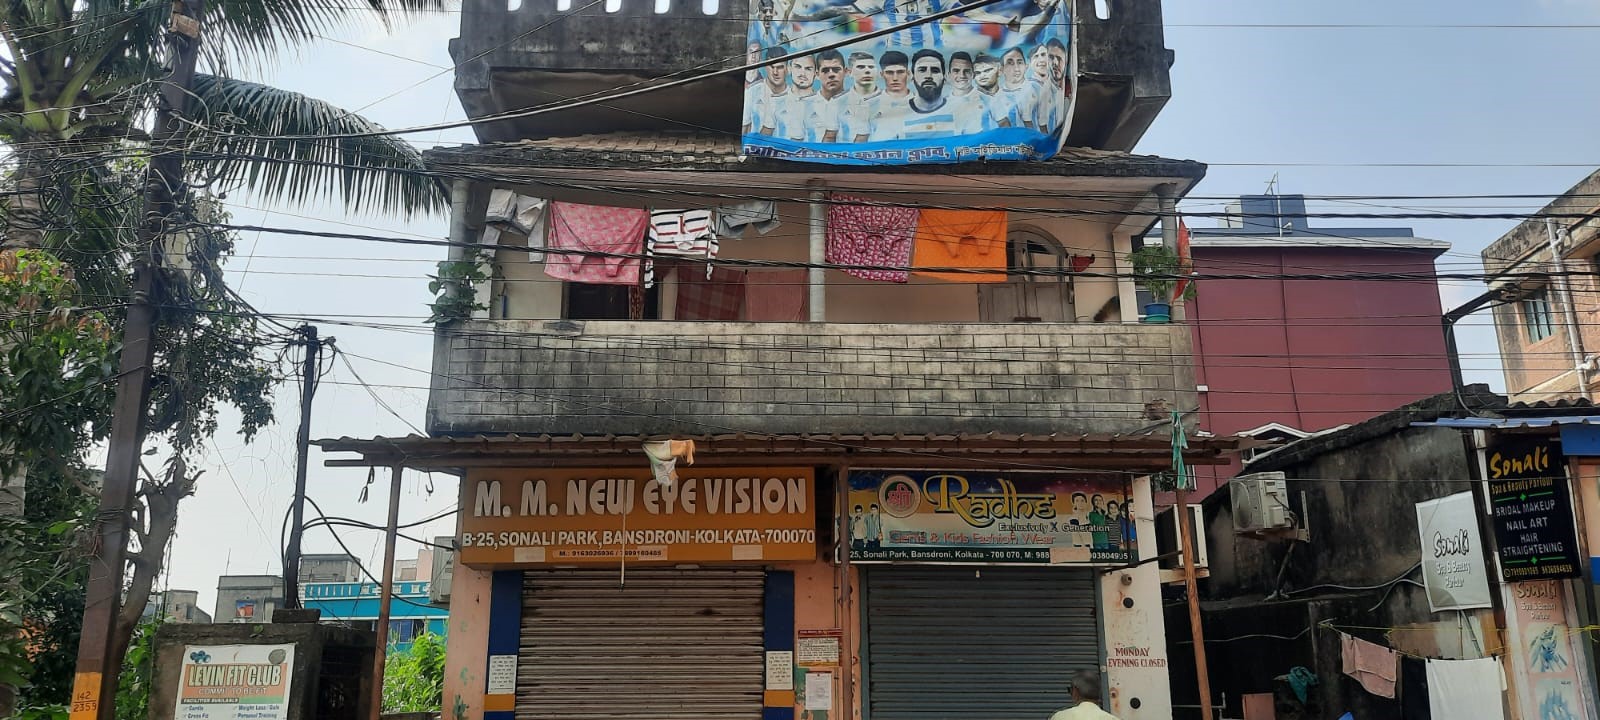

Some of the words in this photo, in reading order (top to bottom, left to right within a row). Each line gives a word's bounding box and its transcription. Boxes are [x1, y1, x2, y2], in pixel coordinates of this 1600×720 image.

[1489, 446, 1549, 479] Sonali
[474, 480, 512, 518] M.
[520, 479, 559, 517] M.
[566, 479, 636, 516] NEW
[643, 478, 697, 515] EYE
[703, 477, 808, 515] VISION
[1495, 503, 1522, 517] BRIDAL
[1522, 499, 1556, 513] MAKEUP
[999, 522, 1049, 533] Exclusively
[1050, 521, 1059, 533] X
[1061, 523, 1110, 533] Generation
[1506, 520, 1528, 531] NAIL
[1529, 517, 1548, 528] ART
[943, 532, 969, 544] Kids
[1022, 532, 1056, 545] Wear
[1432, 528, 1470, 559] Sonali
[1519, 532, 1539, 544] HAIR
[863, 551, 888, 559] Sonali
[889, 551, 909, 560] Park,
[955, 551, 984, 559] Kolkata
[991, 551, 1005, 559] 700
[1503, 542, 1564, 557] STRAIGHTENING
[1115, 647, 1150, 657] MONDAY
[1108, 658, 1140, 668] EVENING
[1140, 658, 1167, 668] CLOSED
[188, 664, 226, 687] LEVIN
[226, 664, 248, 687] FIT
[247, 664, 282, 687] CLUB
[77, 690, 92, 700] 142
[232, 687, 242, 695] TO
[243, 687, 254, 695] BE
[256, 687, 268, 695] FIT
